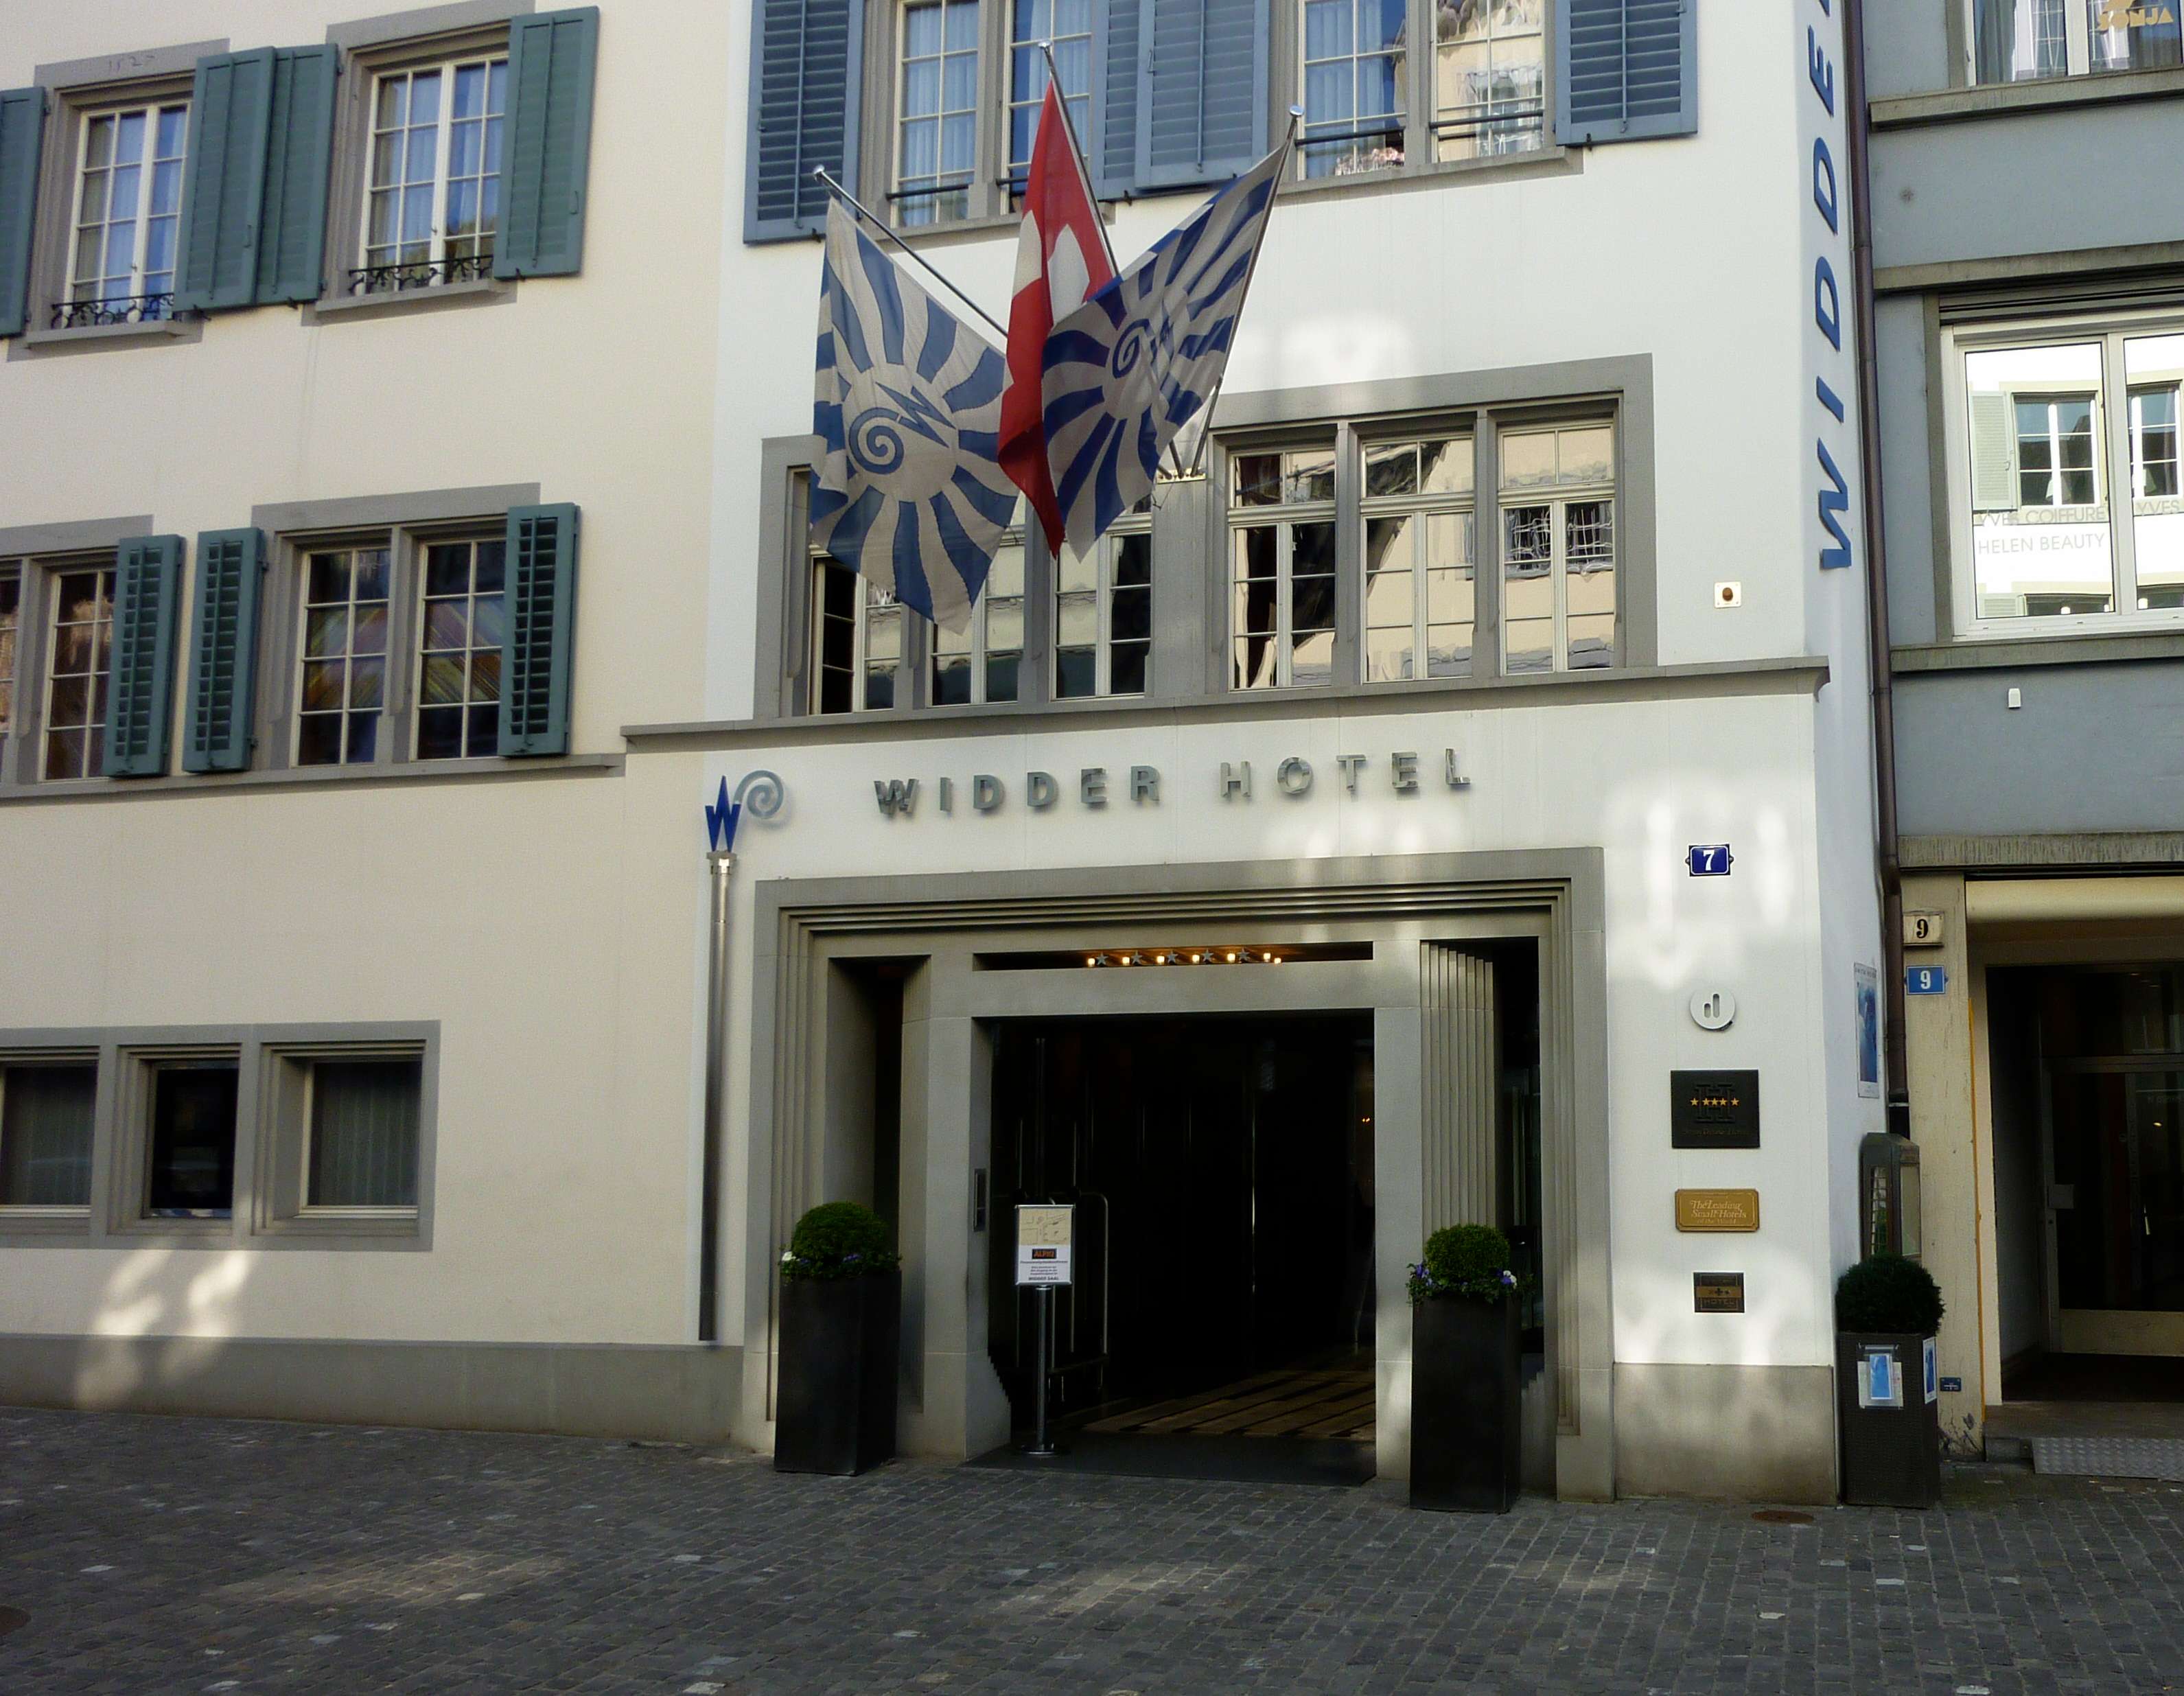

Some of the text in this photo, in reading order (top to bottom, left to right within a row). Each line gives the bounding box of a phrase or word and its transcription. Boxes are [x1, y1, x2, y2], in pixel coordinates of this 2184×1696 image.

[2098, 6, 2174, 31] SONJA
[1807, 0, 1852, 570] WIDDE
[1980, 506, 2106, 526] YVES COIFFURE
[2136, 500, 2181, 515] YVES
[1977, 533, 2105, 555] HELEN BEAUTY
[873, 747, 1472, 815] WIDDER HOTEL
[1703, 850, 1715, 871] 7
[1916, 918, 1929, 939] 9
[1920, 970, 1931, 990] 9
[1718, 1209, 1747, 1218] Hotels
